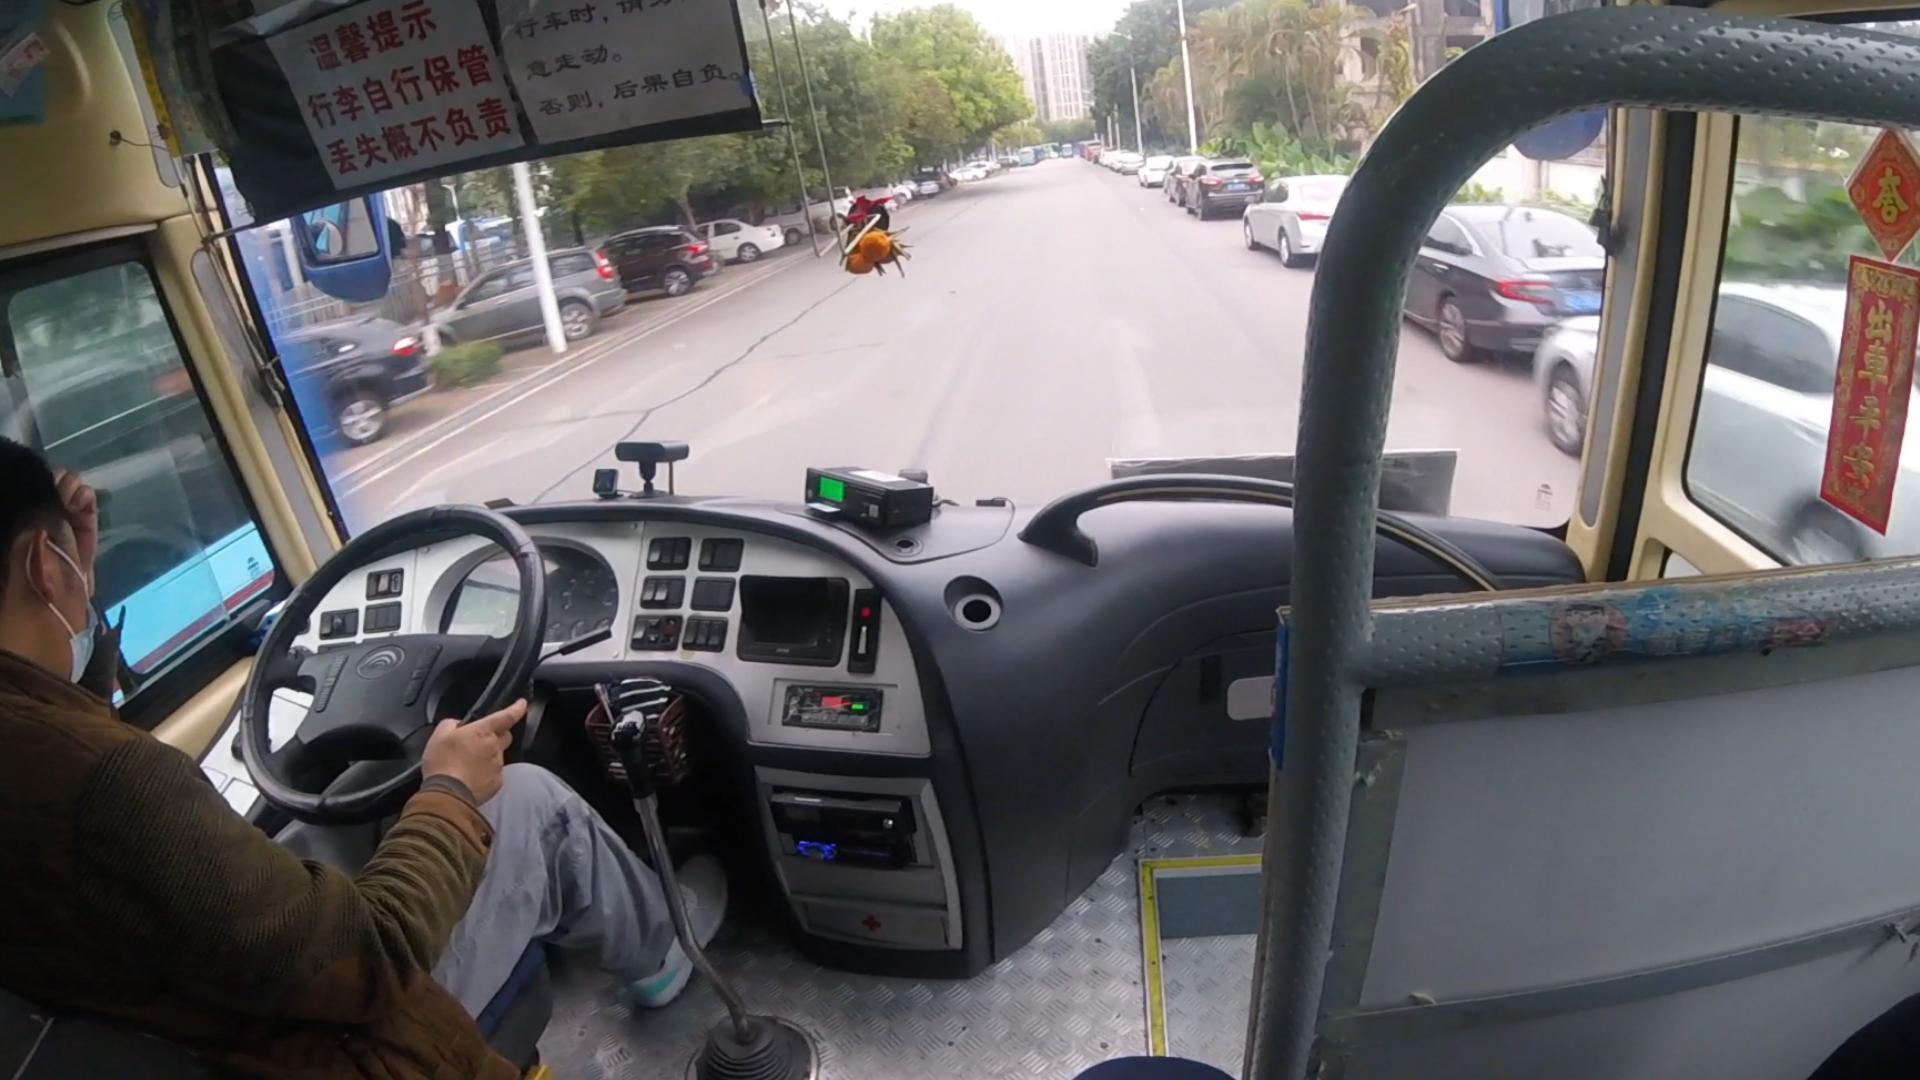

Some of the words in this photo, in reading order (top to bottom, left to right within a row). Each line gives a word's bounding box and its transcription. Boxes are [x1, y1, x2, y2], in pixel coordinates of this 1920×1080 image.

[308, 0, 437, 71] 温馨提示
[308, 43, 493, 129] 行李自行保管
[326, 97, 512, 176] 丢失概不负责
